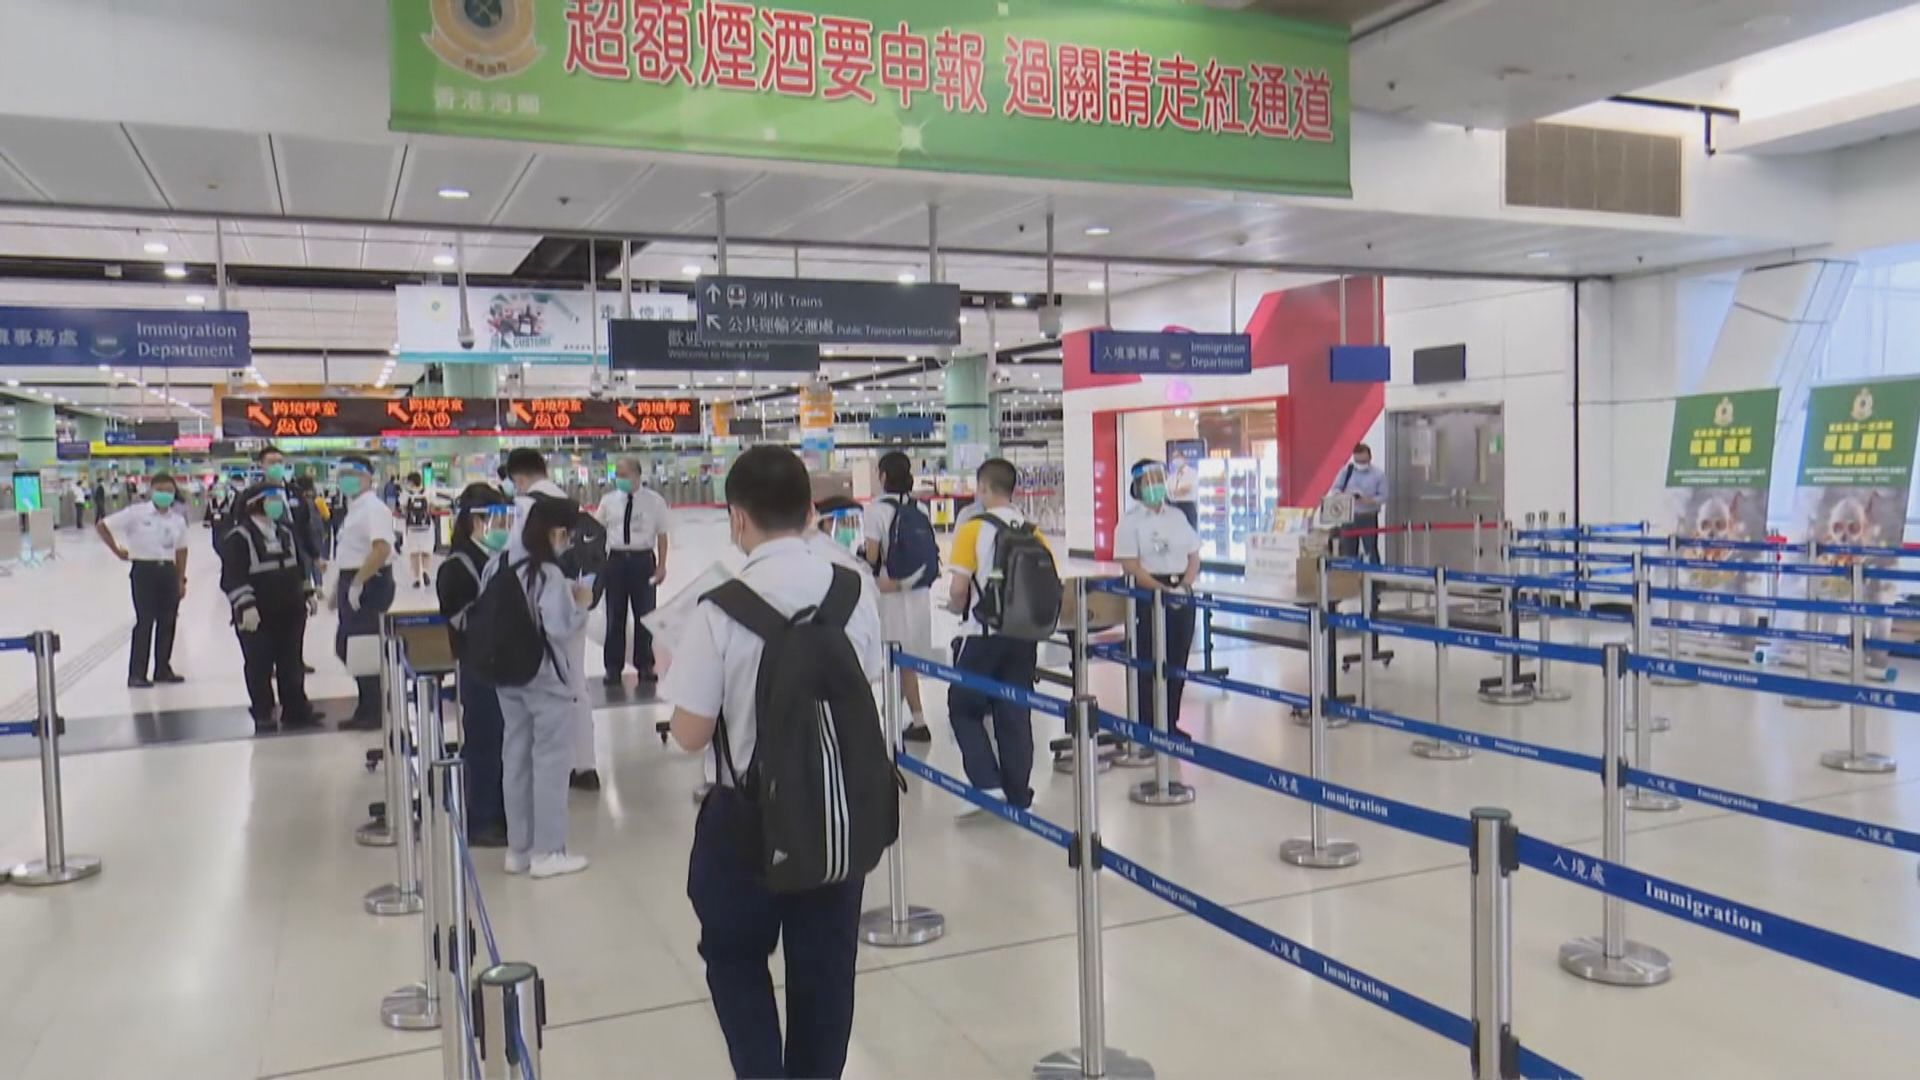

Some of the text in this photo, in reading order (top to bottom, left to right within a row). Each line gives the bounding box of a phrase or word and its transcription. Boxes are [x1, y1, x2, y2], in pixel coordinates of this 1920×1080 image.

[564, 0, 1334, 142] 超額煙酒要申報 過關請走紅通道
[789, 295, 823, 308] Trains
[137, 321, 237, 340] Immigration
[137, 341, 235, 358] Department
[1190, 341, 1246, 356] Immigration
[1190, 356, 1244, 370] Department
[1321, 785, 1389, 818] Immigration
[1552, 853, 1764, 937] 入境處 Immigration
[1322, 959, 1390, 1004] Immigration
